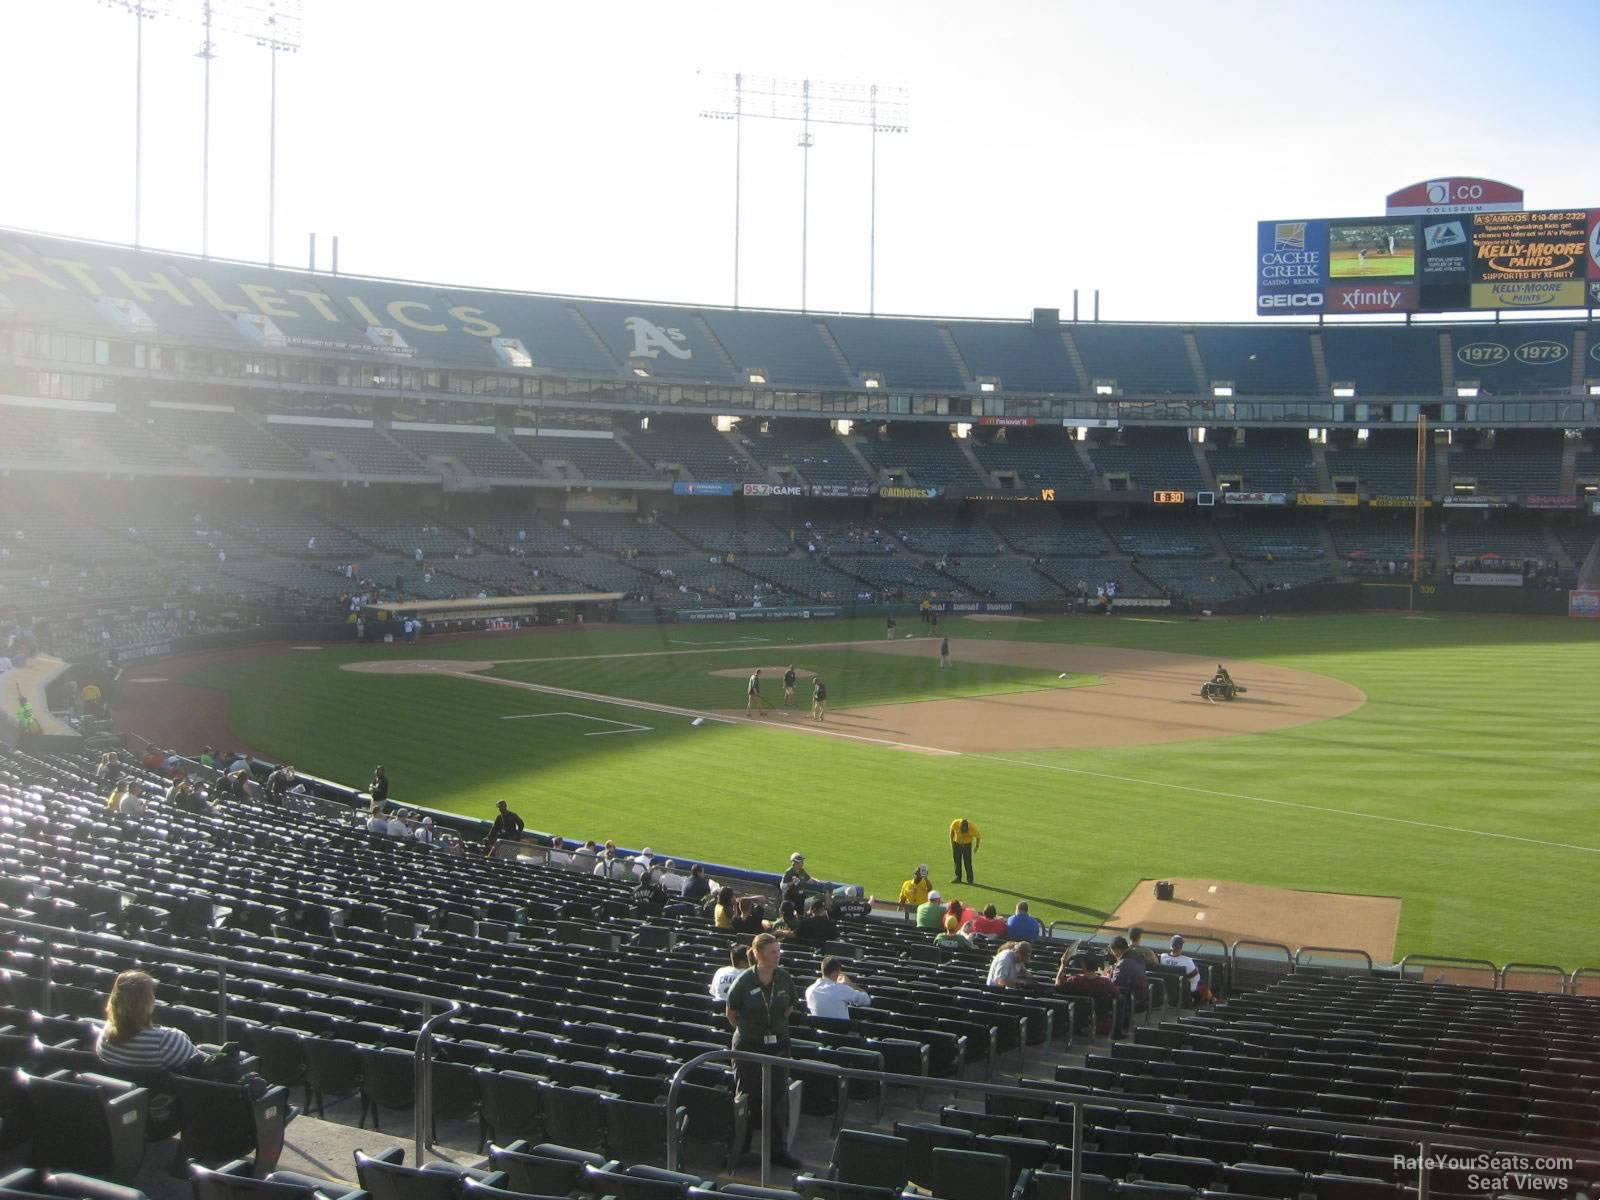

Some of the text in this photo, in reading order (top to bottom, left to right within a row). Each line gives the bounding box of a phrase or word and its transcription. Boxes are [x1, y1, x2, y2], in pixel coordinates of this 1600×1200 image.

[1426, 205, 1483, 214] COLISEUM
[1490, 213, 1528, 223] AMIGOS
[1477, 242, 1586, 259] KELLY-MOORE
[1262, 251, 1320, 265] CACHE
[1508, 256, 1554, 267] PAINTS
[1262, 264, 1320, 278] CREEK
[1482, 270, 1575, 281] SUPPORTED BY XFINITY
[1293, 277, 1320, 285] RESORT
[0, 247, 501, 338] ATHLETICS
[1491, 282, 1563, 294] KELLY-MOORE
[1259, 293, 1324, 308] GEICO
[1342, 288, 1402, 309] xfinity
[1512, 294, 1543, 302] PAINTS
[1463, 347, 1504, 360] 1972
[1521, 346, 1562, 359] 1973
[744, 485, 769, 496] 95.7
[773, 486, 801, 496] GAME
[880, 486, 927, 498] @Athletics
[1042, 489, 1055, 501] VS
[1160, 492, 1181, 502] 6:30
